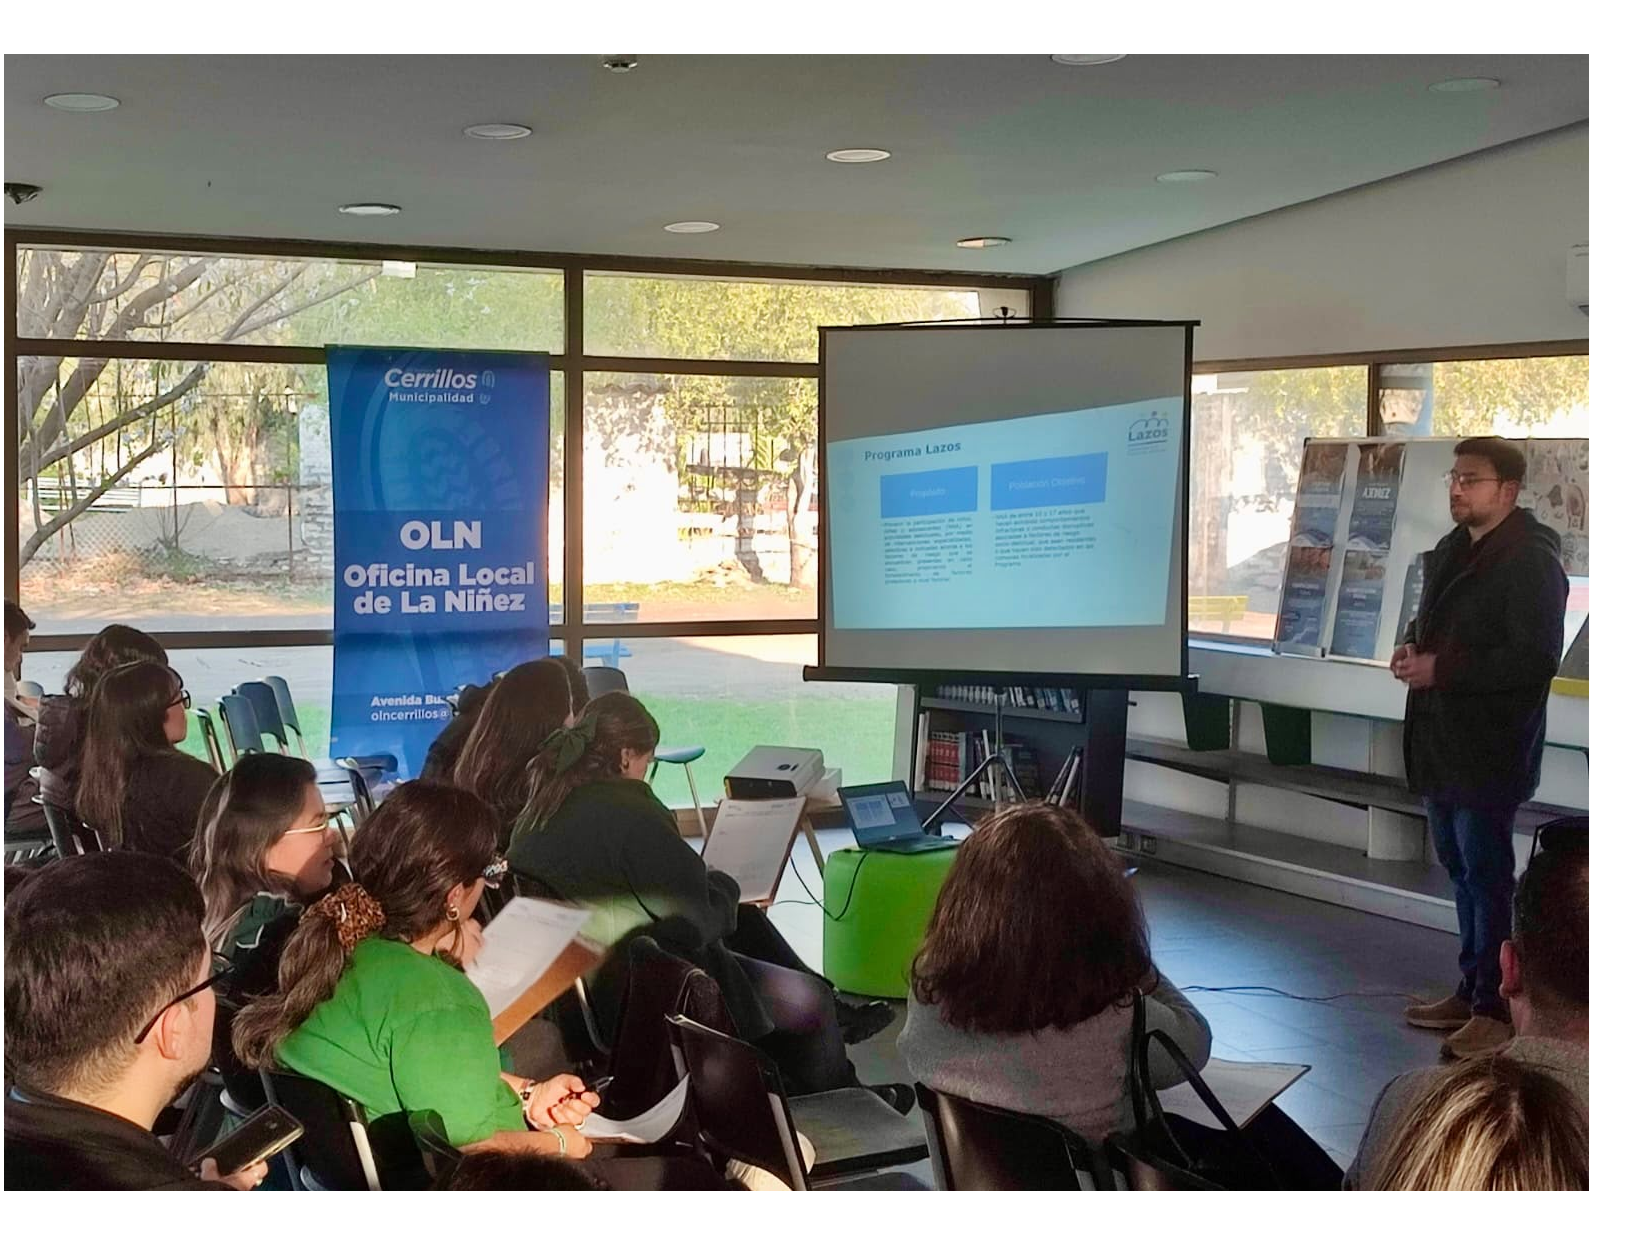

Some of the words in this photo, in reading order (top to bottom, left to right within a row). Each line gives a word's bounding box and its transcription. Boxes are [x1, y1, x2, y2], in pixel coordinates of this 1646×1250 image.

[384, 367, 478, 390] Cerrillos
[389, 391, 474, 404] Municipalidad
[1129, 429, 1168, 441] Lazos
[864, 446, 922, 461] Programa
[926, 442, 962, 455] Lazos
[400, 520, 481, 550] OLN
[343, 563, 450, 588] Oficina
[459, 561, 534, 586] Local
[354, 590, 391, 614] de
[401, 591, 436, 613] La
[445, 588, 525, 612] Niñez
[371, 695, 422, 707] Avenida
